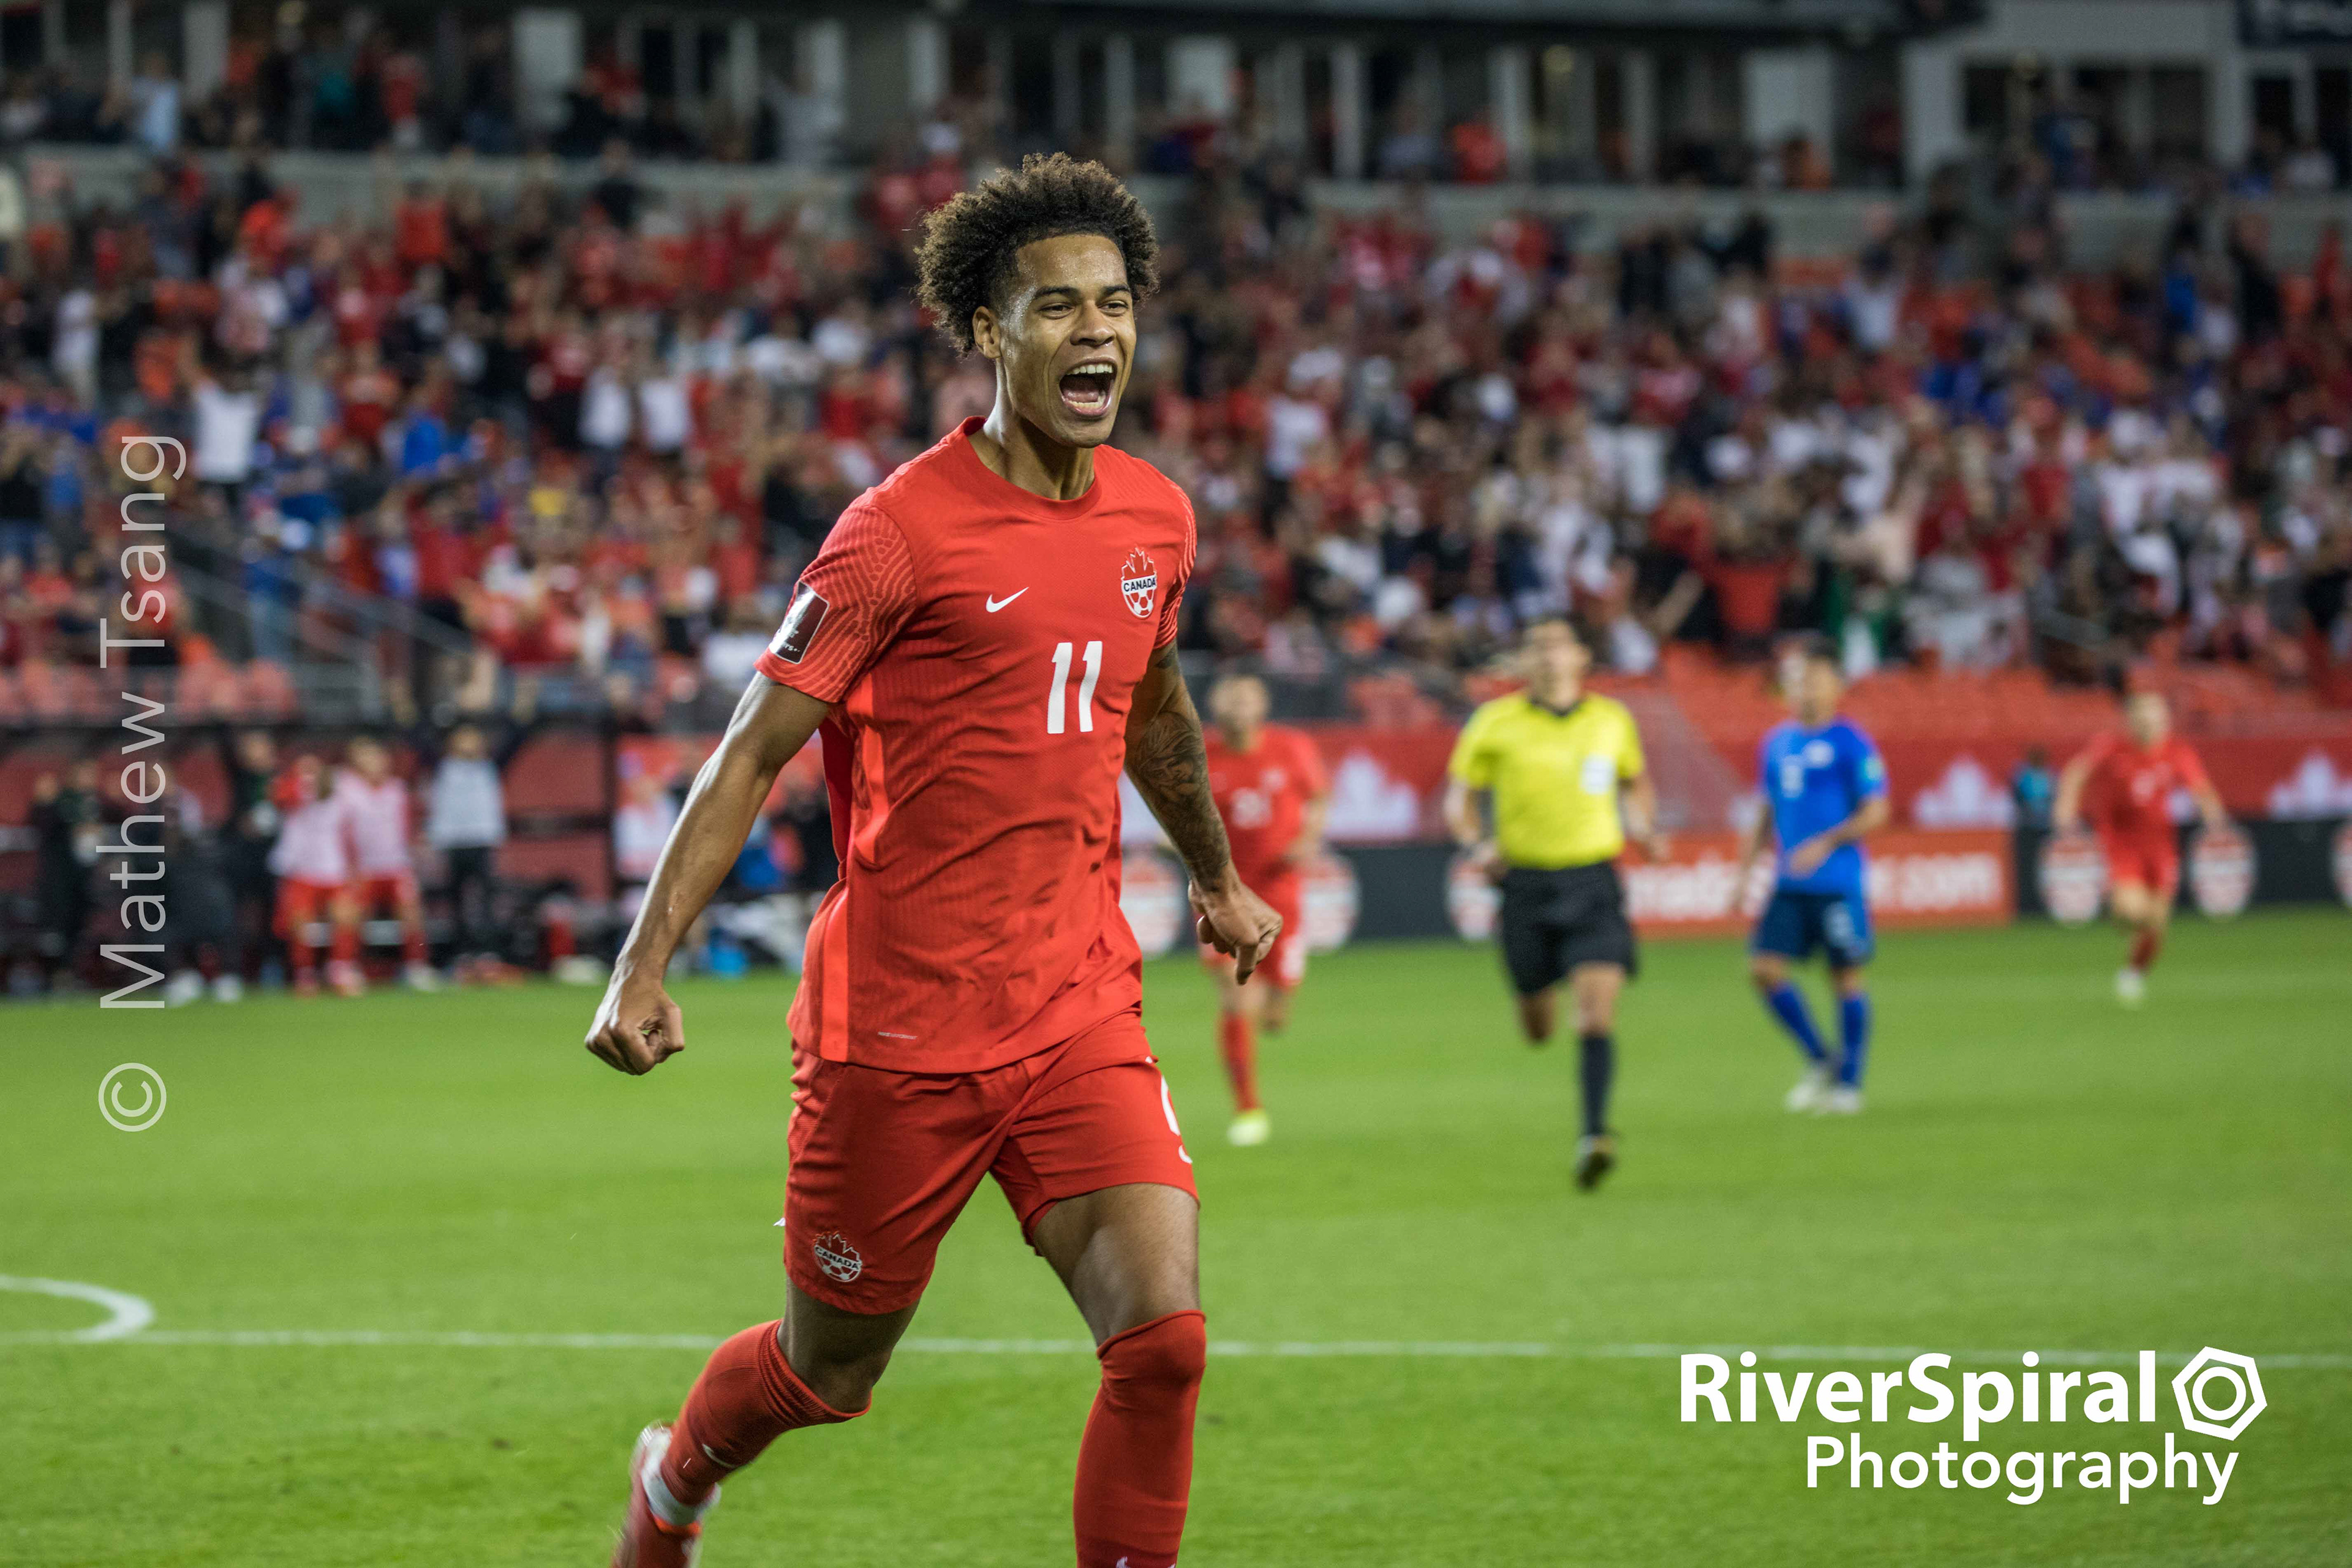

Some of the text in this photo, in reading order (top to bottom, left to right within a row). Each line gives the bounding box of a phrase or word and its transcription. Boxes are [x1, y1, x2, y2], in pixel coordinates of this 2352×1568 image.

[1123, 578, 1156, 592] CANADA
[1047, 641, 1102, 734] 11
[815, 1246, 858, 1269] CANADA
